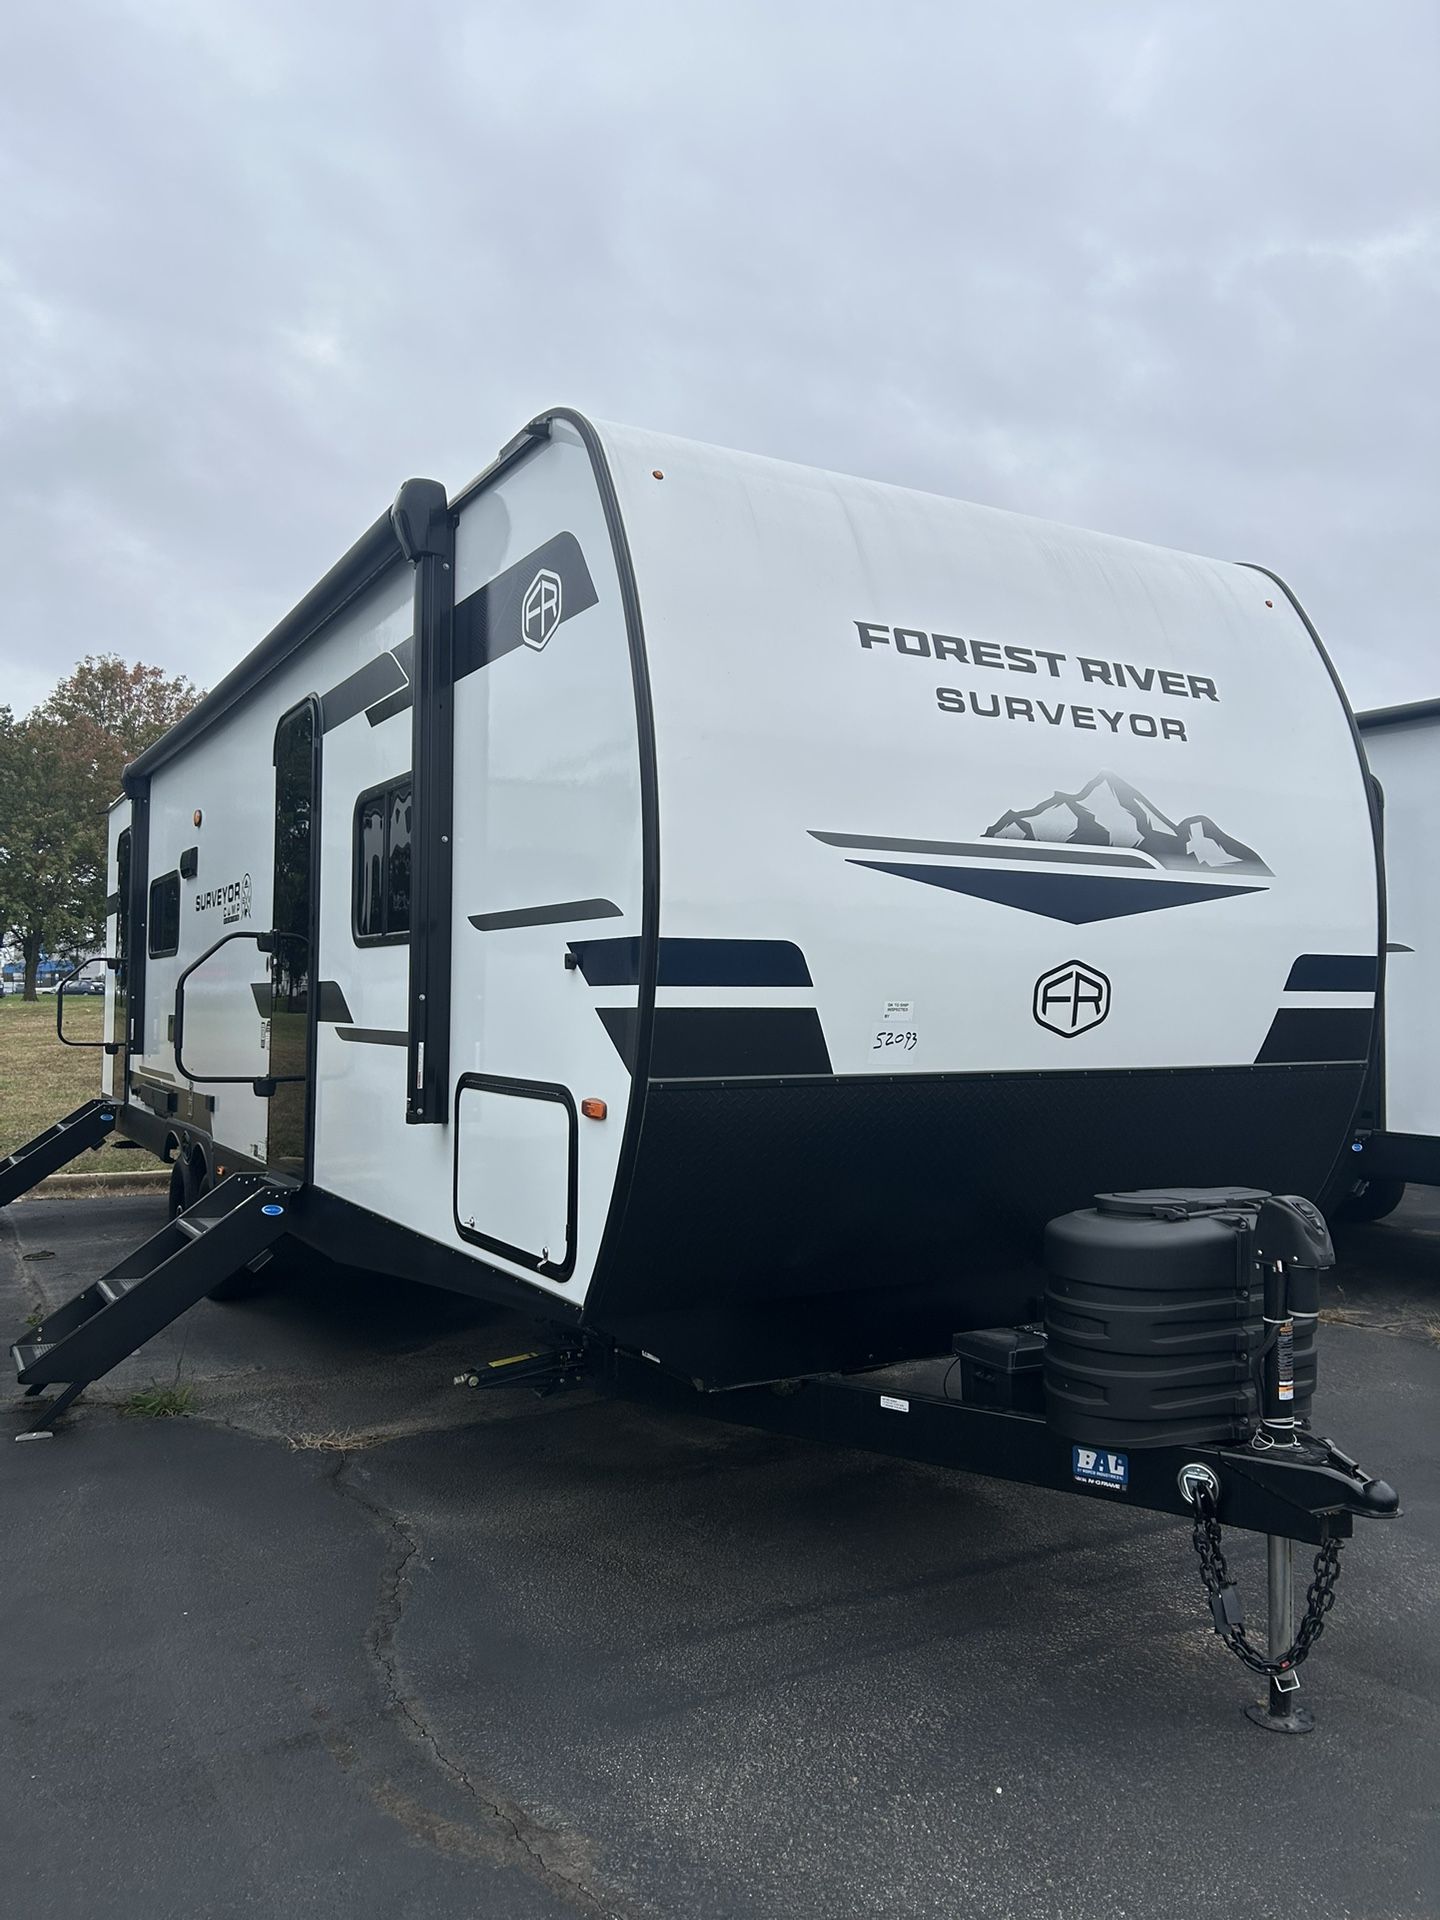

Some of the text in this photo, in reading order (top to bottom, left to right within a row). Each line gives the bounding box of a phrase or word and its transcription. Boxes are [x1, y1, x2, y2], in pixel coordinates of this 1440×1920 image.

[853, 620, 1220, 702] FOREST RIVER
[935, 687, 1188, 742] SURVEYOR
[195, 881, 241, 912] SURVEYOR
[872, 1031, 918, 1051] 52093
[1077, 1449, 1125, 1476] BAL
